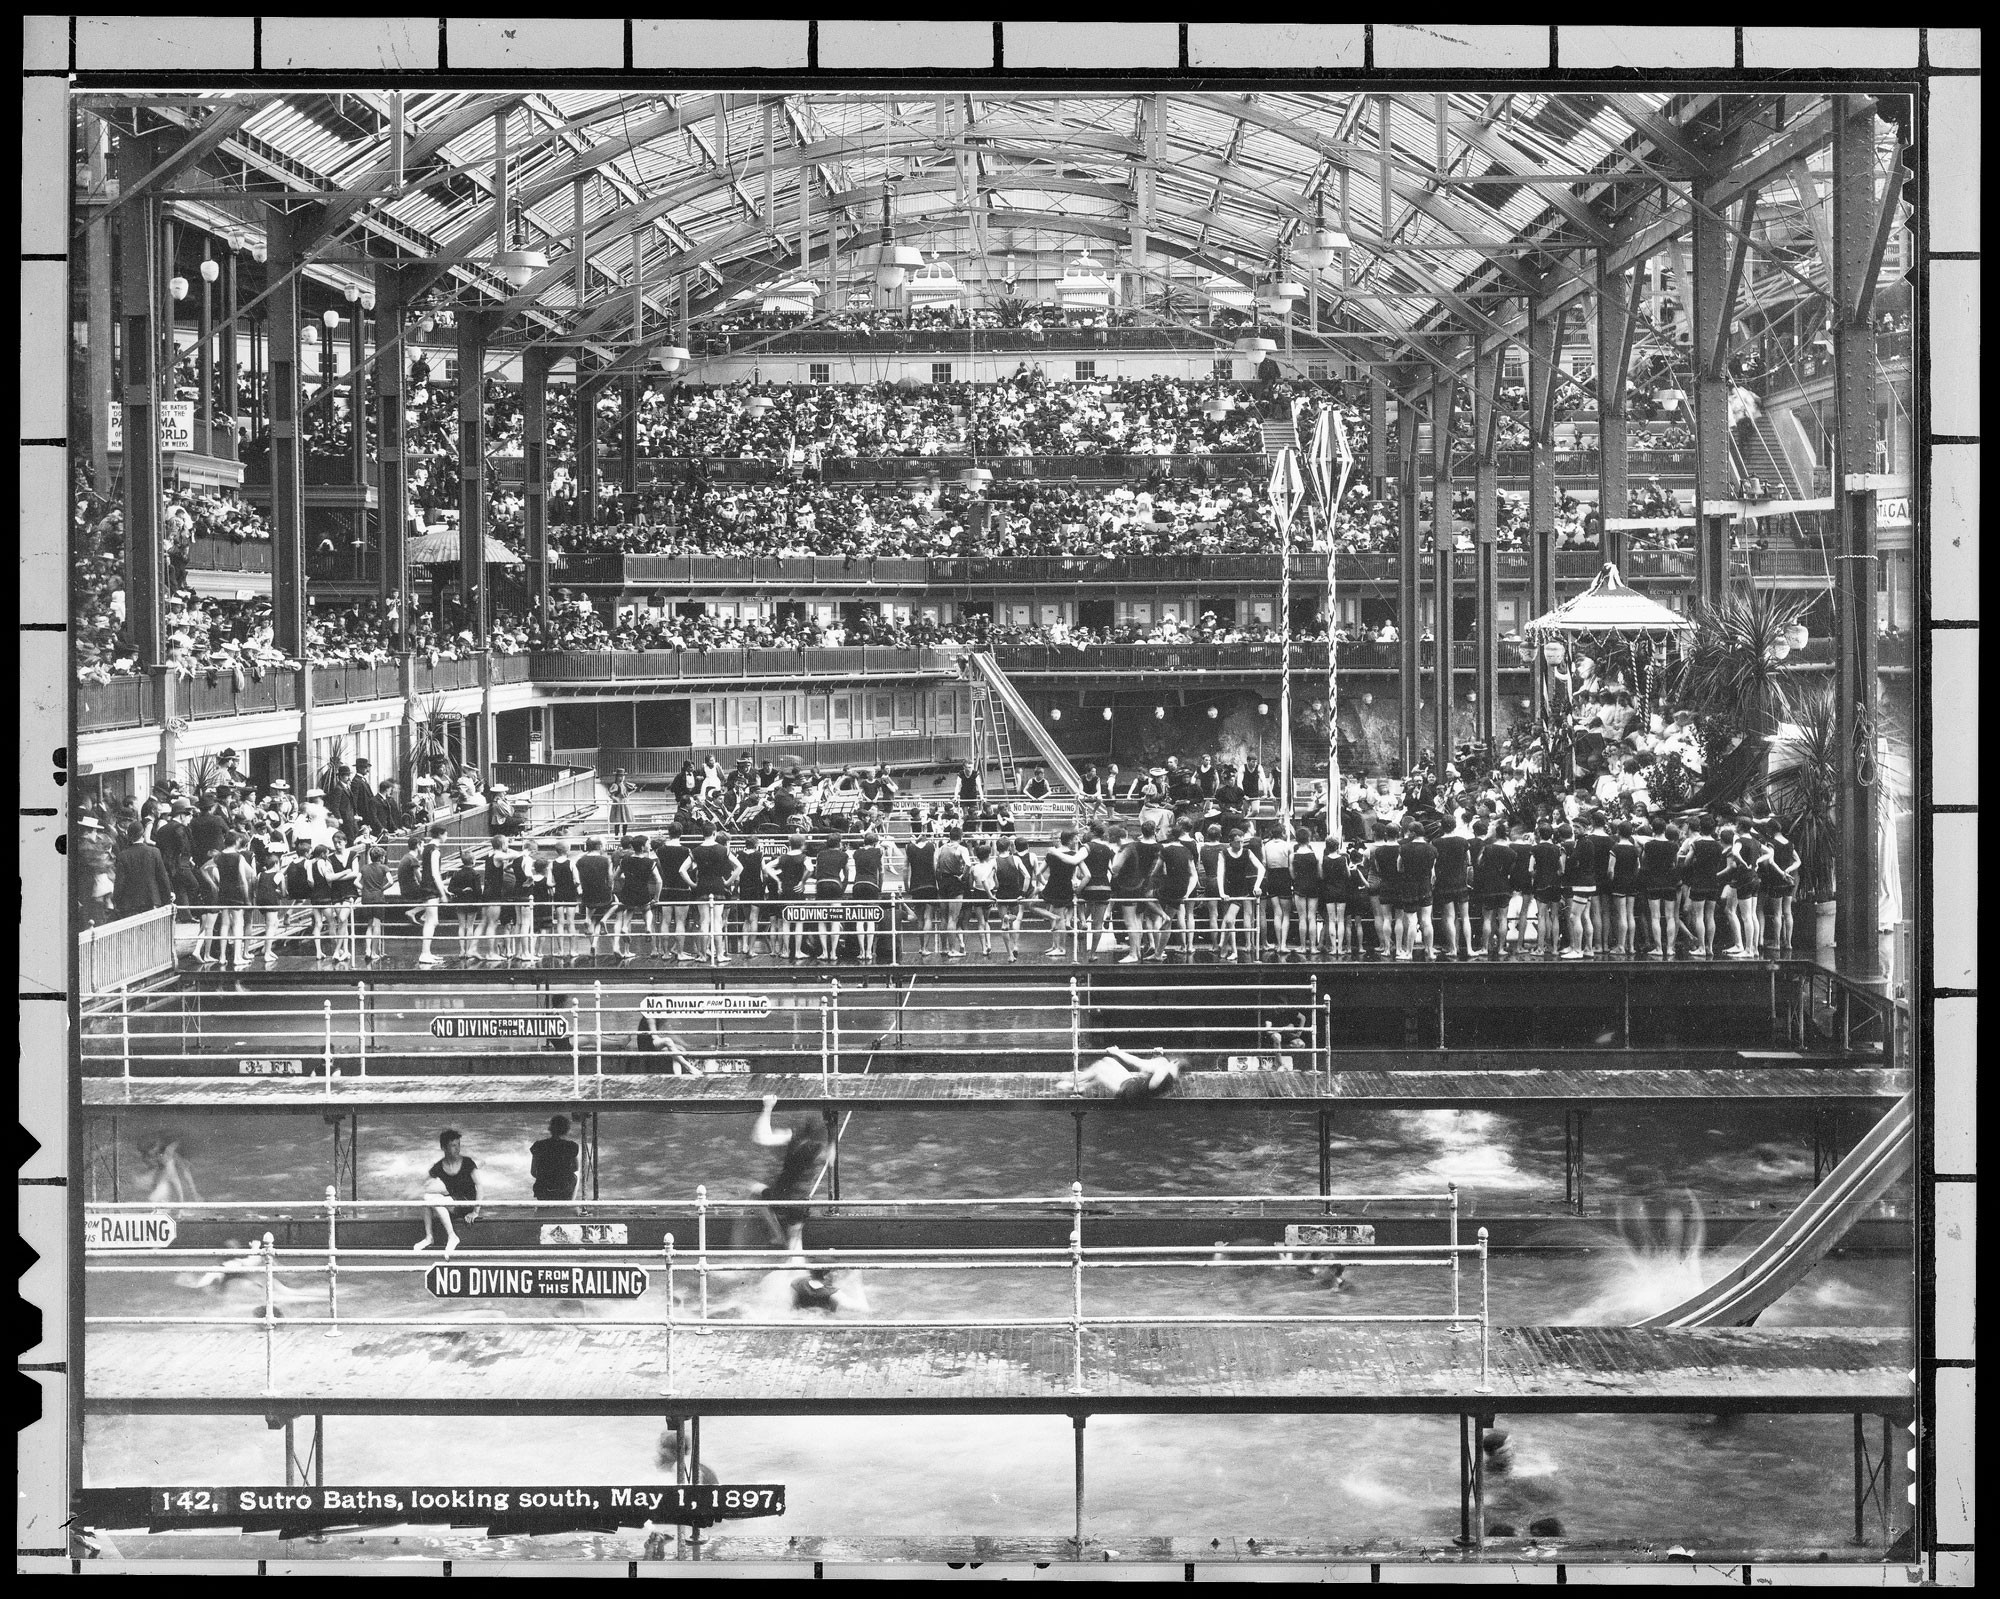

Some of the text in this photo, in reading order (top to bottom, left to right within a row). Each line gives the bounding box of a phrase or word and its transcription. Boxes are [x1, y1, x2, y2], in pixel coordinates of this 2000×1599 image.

[1013, 802, 1022, 812] NO
[1022, 802, 1043, 812] DIVING
[1052, 802, 1075, 812] RAILING
[787, 908, 799, 920] NO
[800, 908, 828, 920] DIVING
[845, 908, 880, 920] RAILING
[647, 998, 663, 1014] NO
[666, 998, 704, 1014] DIVING
[724, 998, 768, 1014] RAILING
[436, 1019, 452, 1036] NO
[458, 1019, 497, 1036] DIVING
[518, 1018, 564, 1036] RAILING
[102, 1218, 170, 1242] RAILING
[436, 1267, 642, 1296] NO DIVING FROM THIS RAILING
